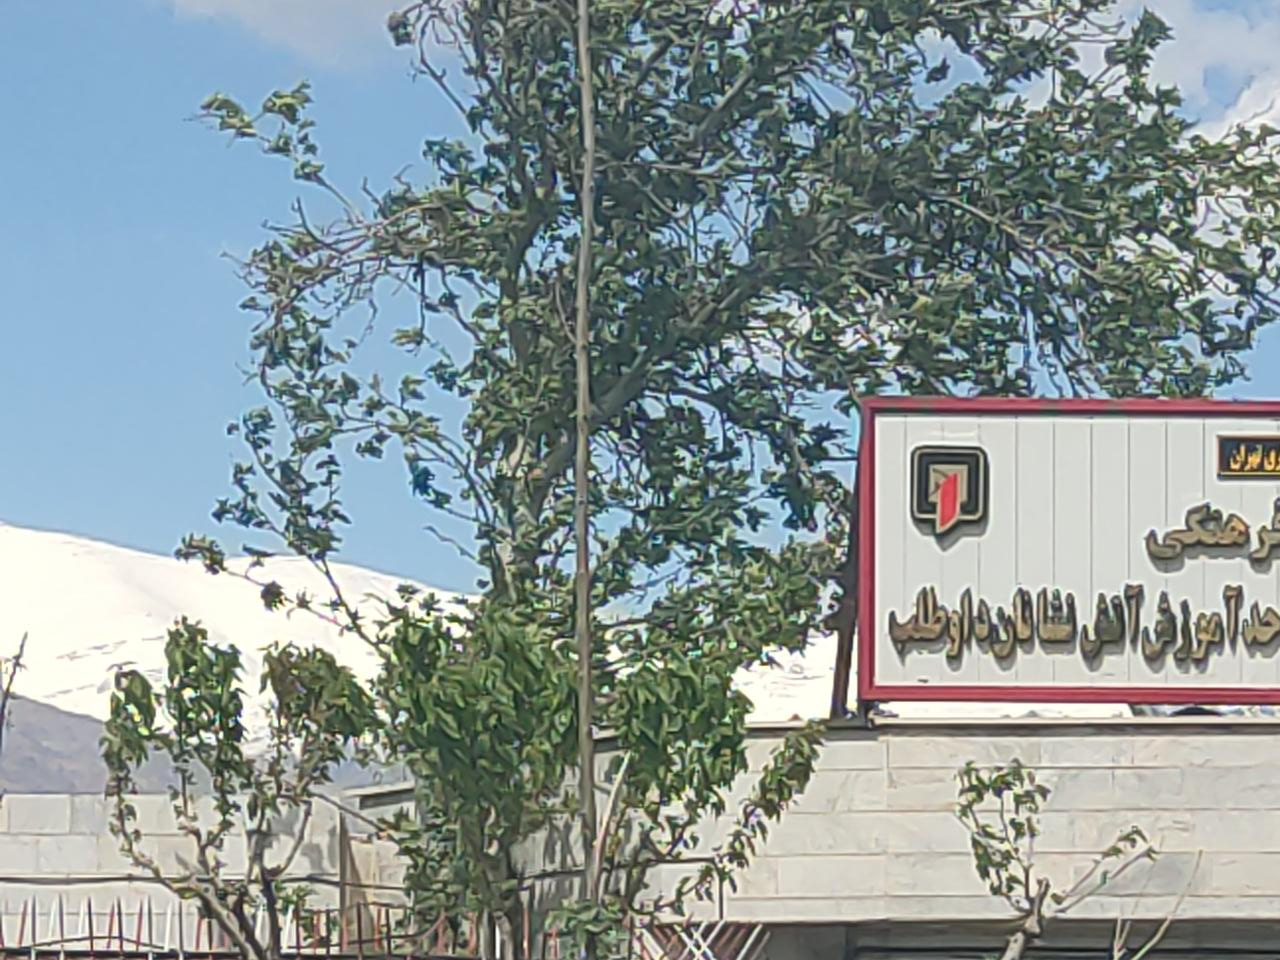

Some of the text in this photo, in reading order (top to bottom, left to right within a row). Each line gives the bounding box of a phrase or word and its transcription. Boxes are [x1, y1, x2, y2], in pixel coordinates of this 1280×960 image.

[1230, 443, 1263, 471] تهران
[889, 586, 991, 658] داوطلب
[1081, 585, 1144, 658] آتش
[1142, 585, 1243, 660] آموزش
